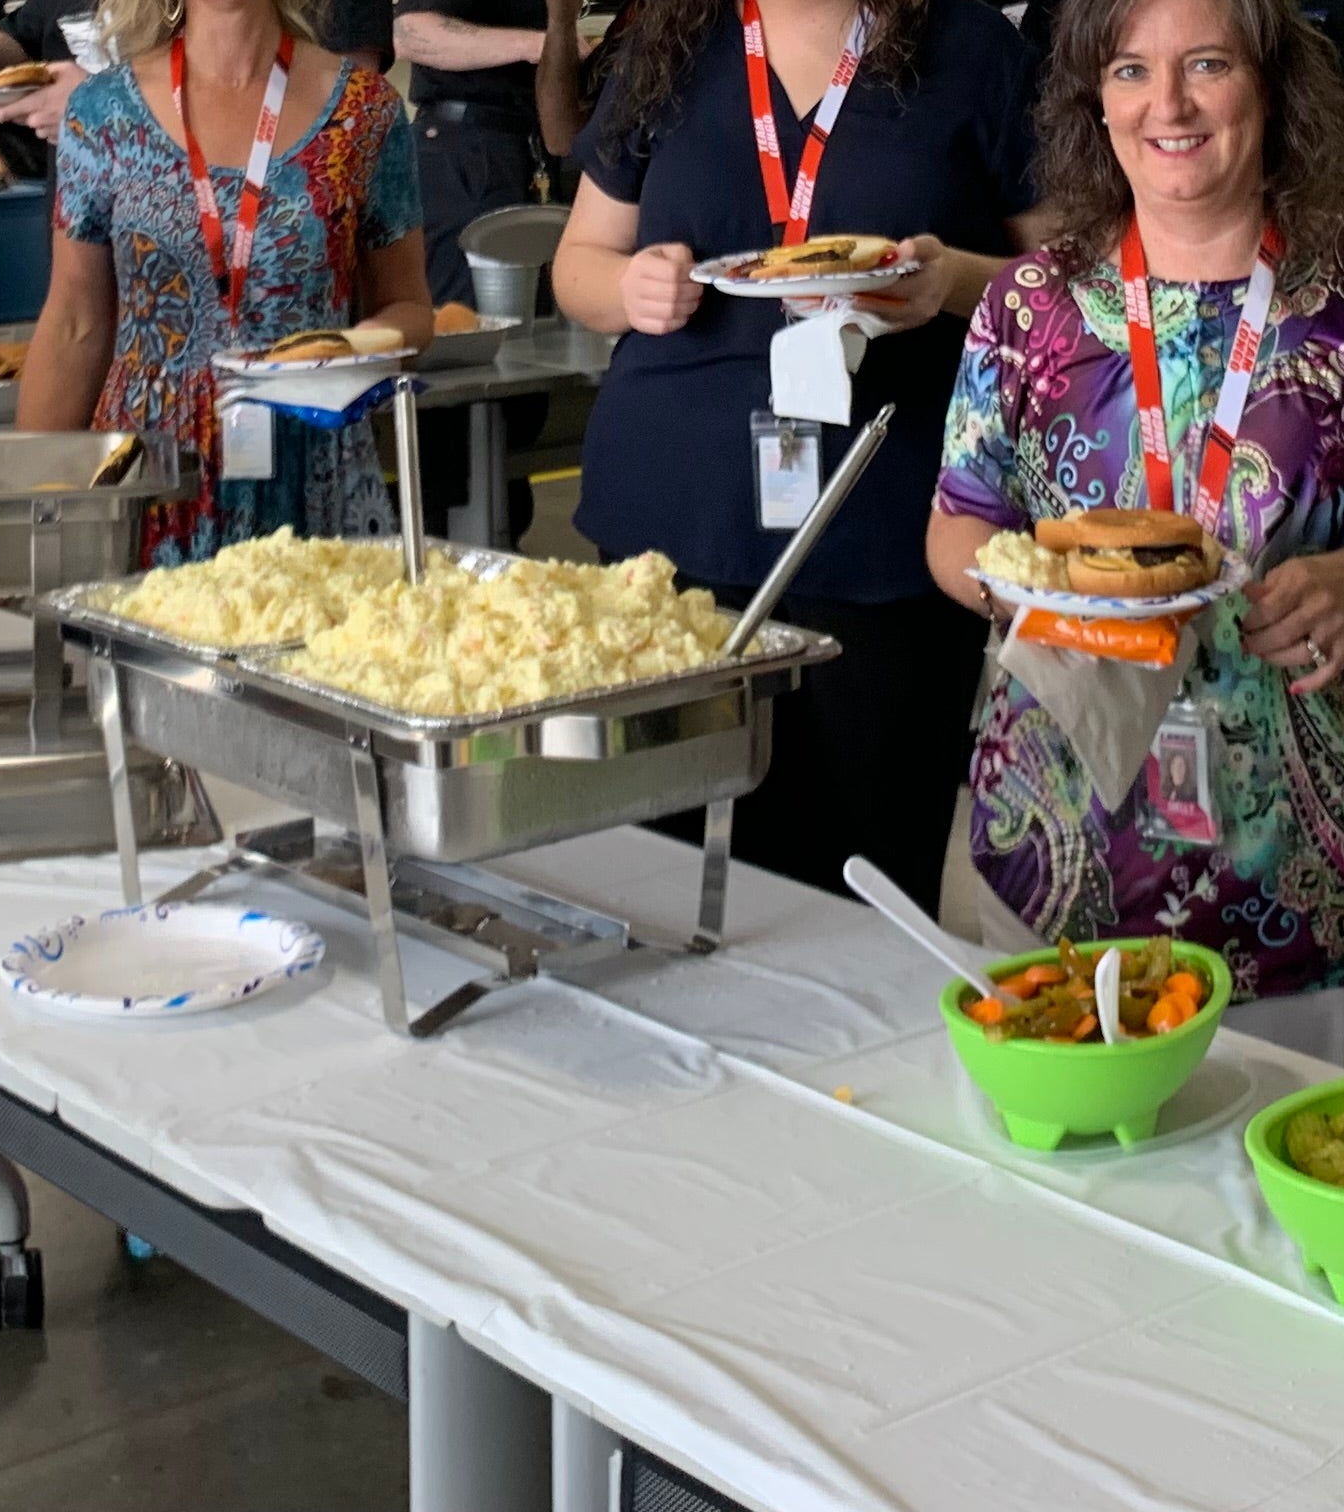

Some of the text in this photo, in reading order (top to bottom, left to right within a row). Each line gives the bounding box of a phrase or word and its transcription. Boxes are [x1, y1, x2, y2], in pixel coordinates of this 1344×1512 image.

[831, 48, 853, 88] LONGO
[754, 118, 768, 153] TEAM
[762, 114, 780, 158] LONGO
[1124, 281, 1139, 323] TEAM
[1134, 276, 1151, 329] LONGO
[1229, 319, 1251, 374] LONGO
[1240, 332, 1261, 374] TEAM
